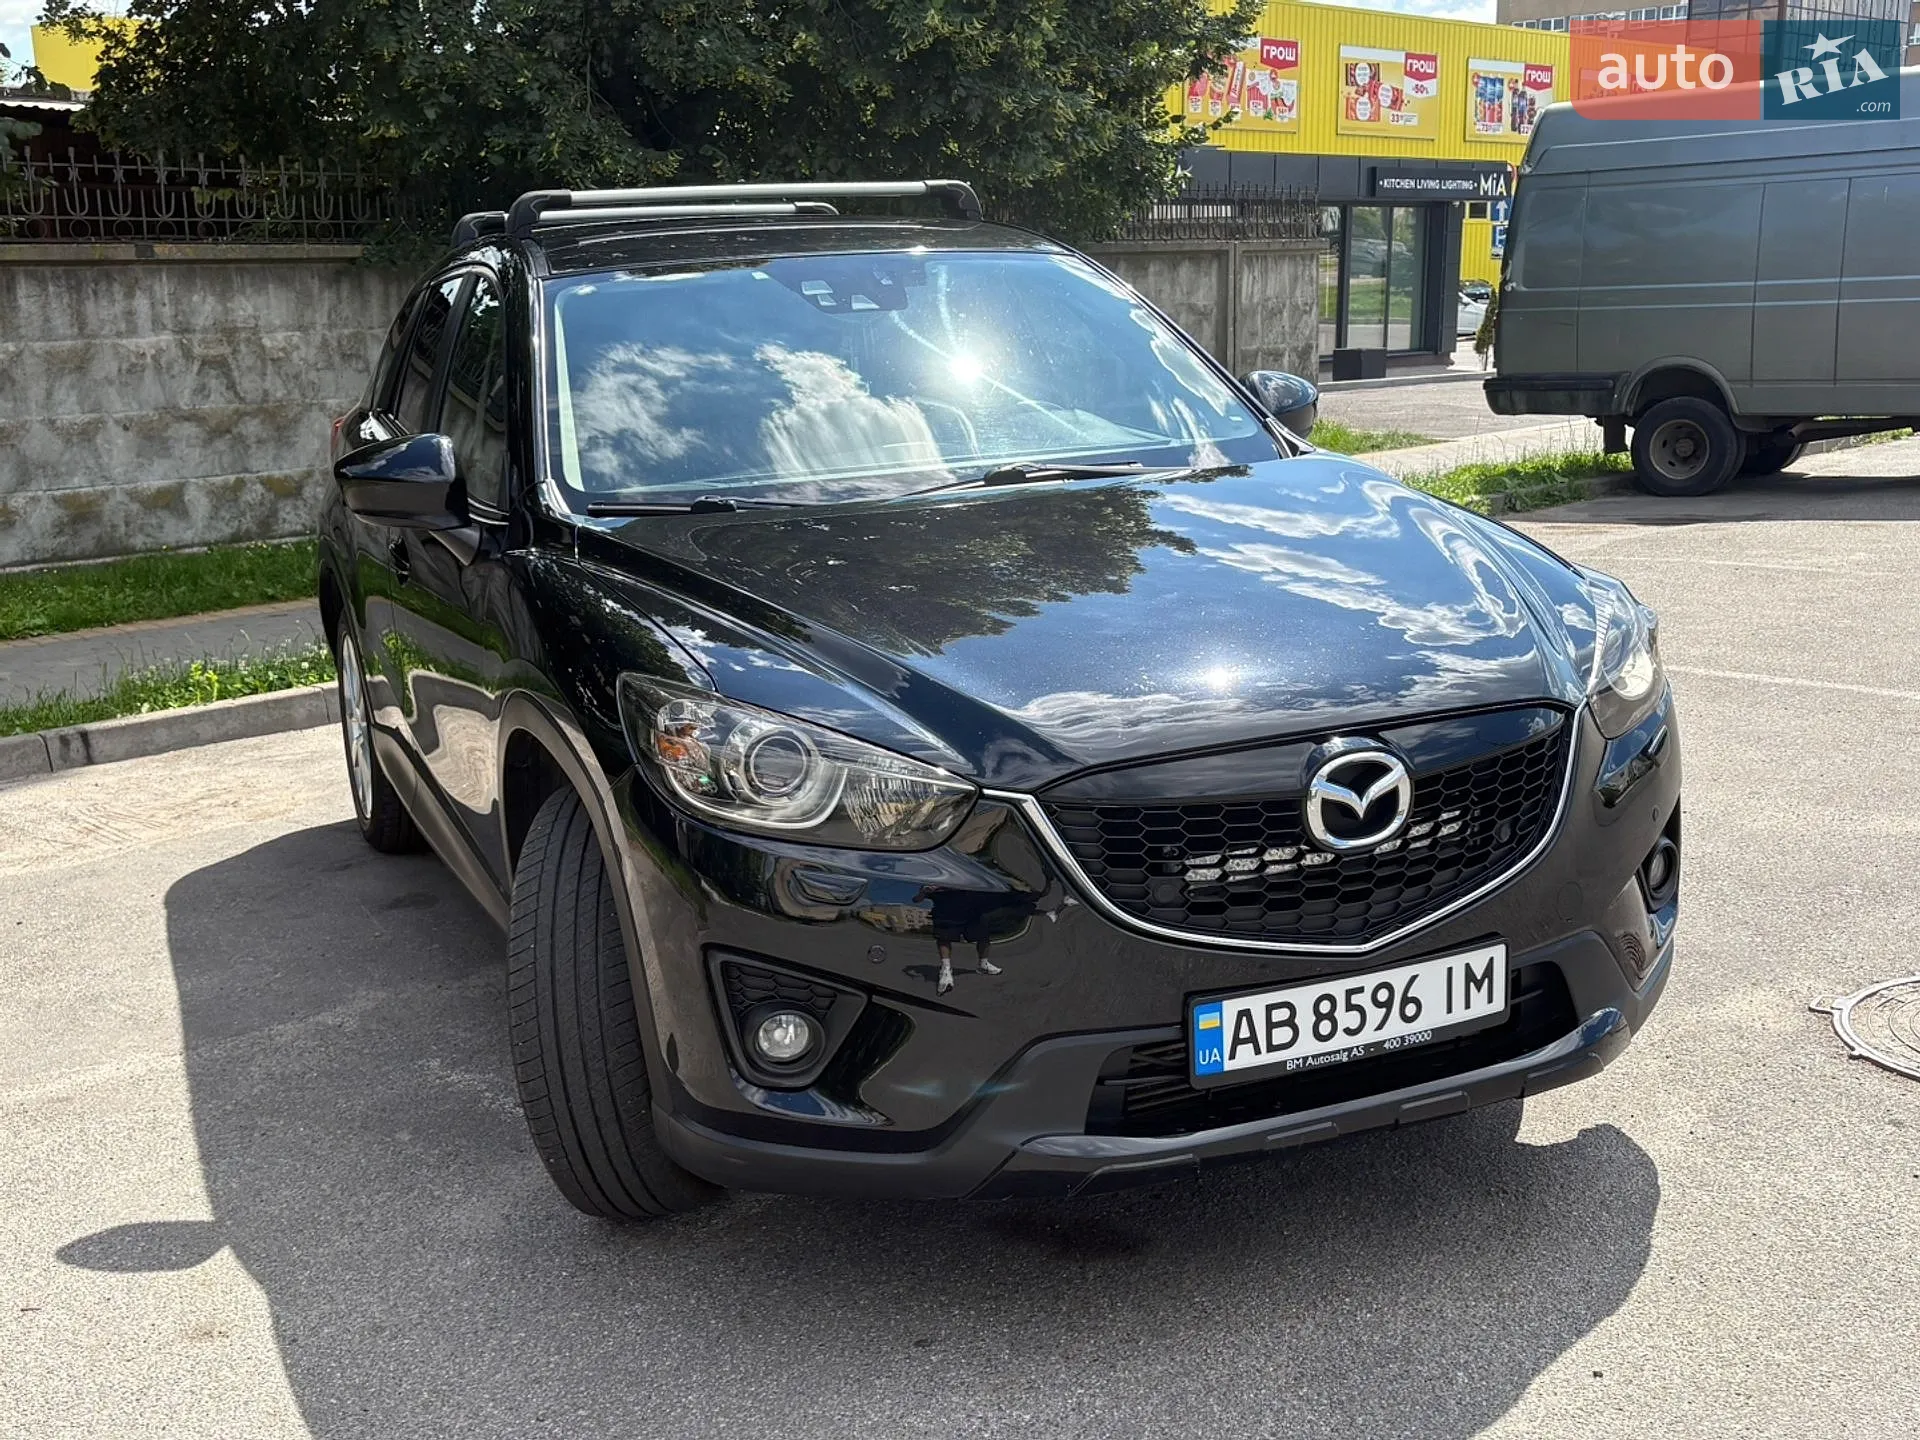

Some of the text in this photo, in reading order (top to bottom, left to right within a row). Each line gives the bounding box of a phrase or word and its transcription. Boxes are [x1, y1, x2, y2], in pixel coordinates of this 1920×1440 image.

[1262, 45, 1296, 61] ГРОШ
[1406, 59, 1436, 74] ГРОШ
[1525, 69, 1552, 83] ГРОШ
[1383, 178, 1474, 191] KITCHEN LIVING LIGHTING
[1228, 956, 1494, 1061] AB 8596 IM
[1199, 1048, 1222, 1065] UA
[1286, 1059, 1303, 1071] BM
[1306, 1049, 1349, 1067] Autosalg
[1350, 1045, 1365, 1058] AS
[1383, 1038, 1401, 1050] 400
[1403, 1030, 1432, 1046] 39000
